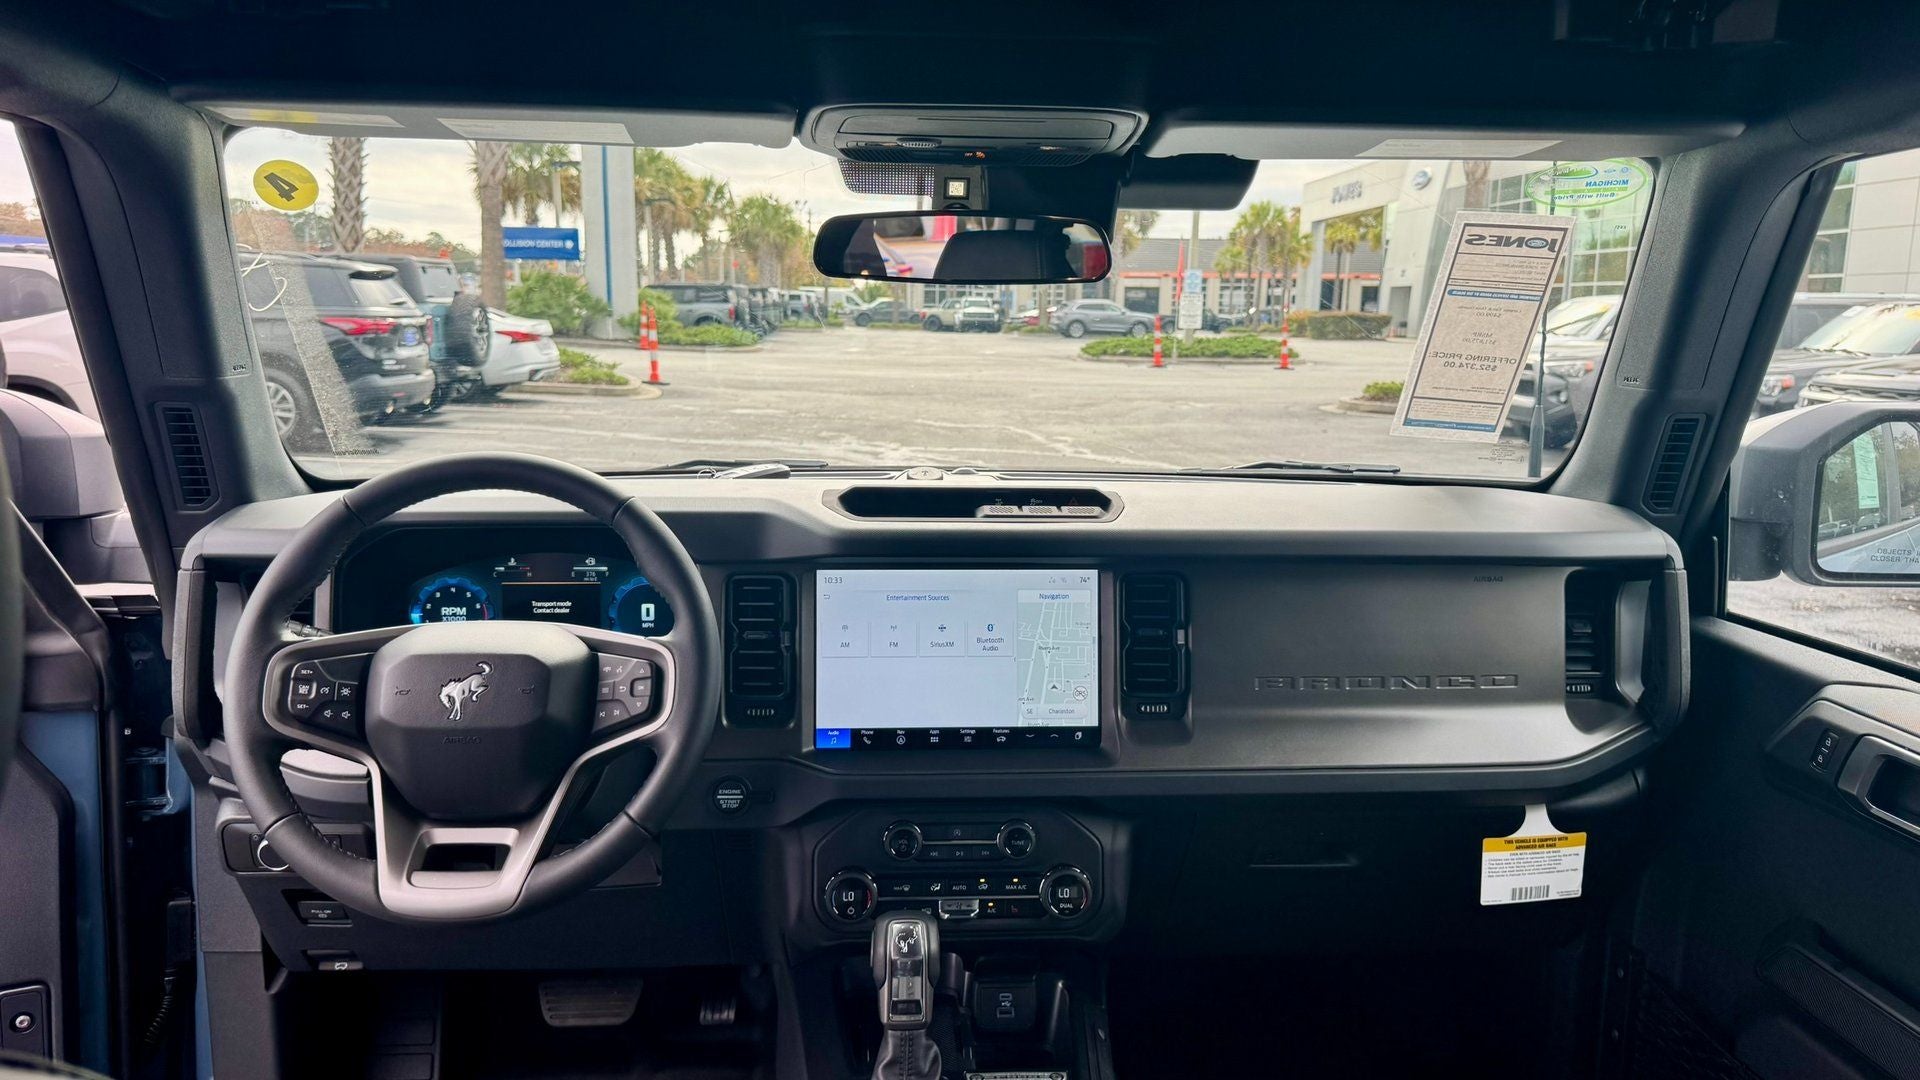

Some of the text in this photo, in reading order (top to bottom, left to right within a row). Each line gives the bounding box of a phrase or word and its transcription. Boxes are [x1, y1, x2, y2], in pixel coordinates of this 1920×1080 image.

[441, 607, 466, 616] RPM
[1254, 674, 1518, 690] BRONCO
[842, 892, 854, 901] LO
[1059, 888, 1070, 898] LO
